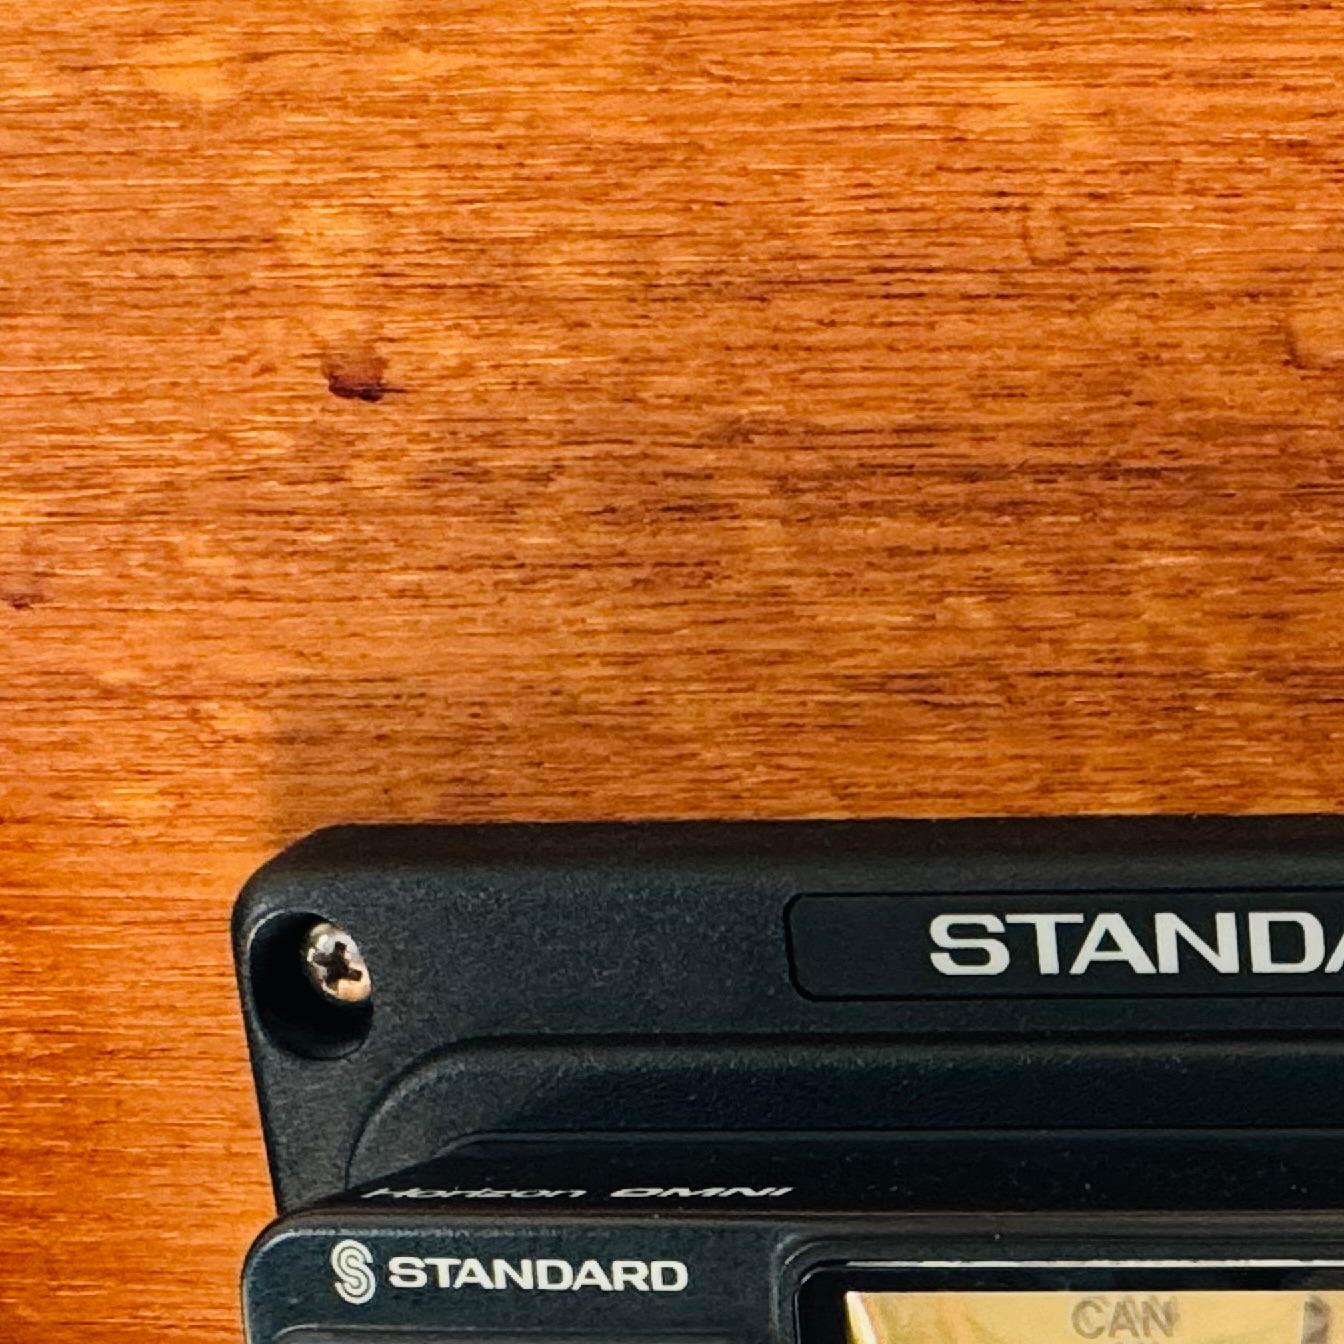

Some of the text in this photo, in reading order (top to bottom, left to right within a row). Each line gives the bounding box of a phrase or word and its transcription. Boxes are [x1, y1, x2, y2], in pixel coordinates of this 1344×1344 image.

[361, 1185, 795, 1199] Horizon OMNI
[388, 1256, 689, 1292] STANDARD
[1070, 1297, 1181, 1340] CAN
